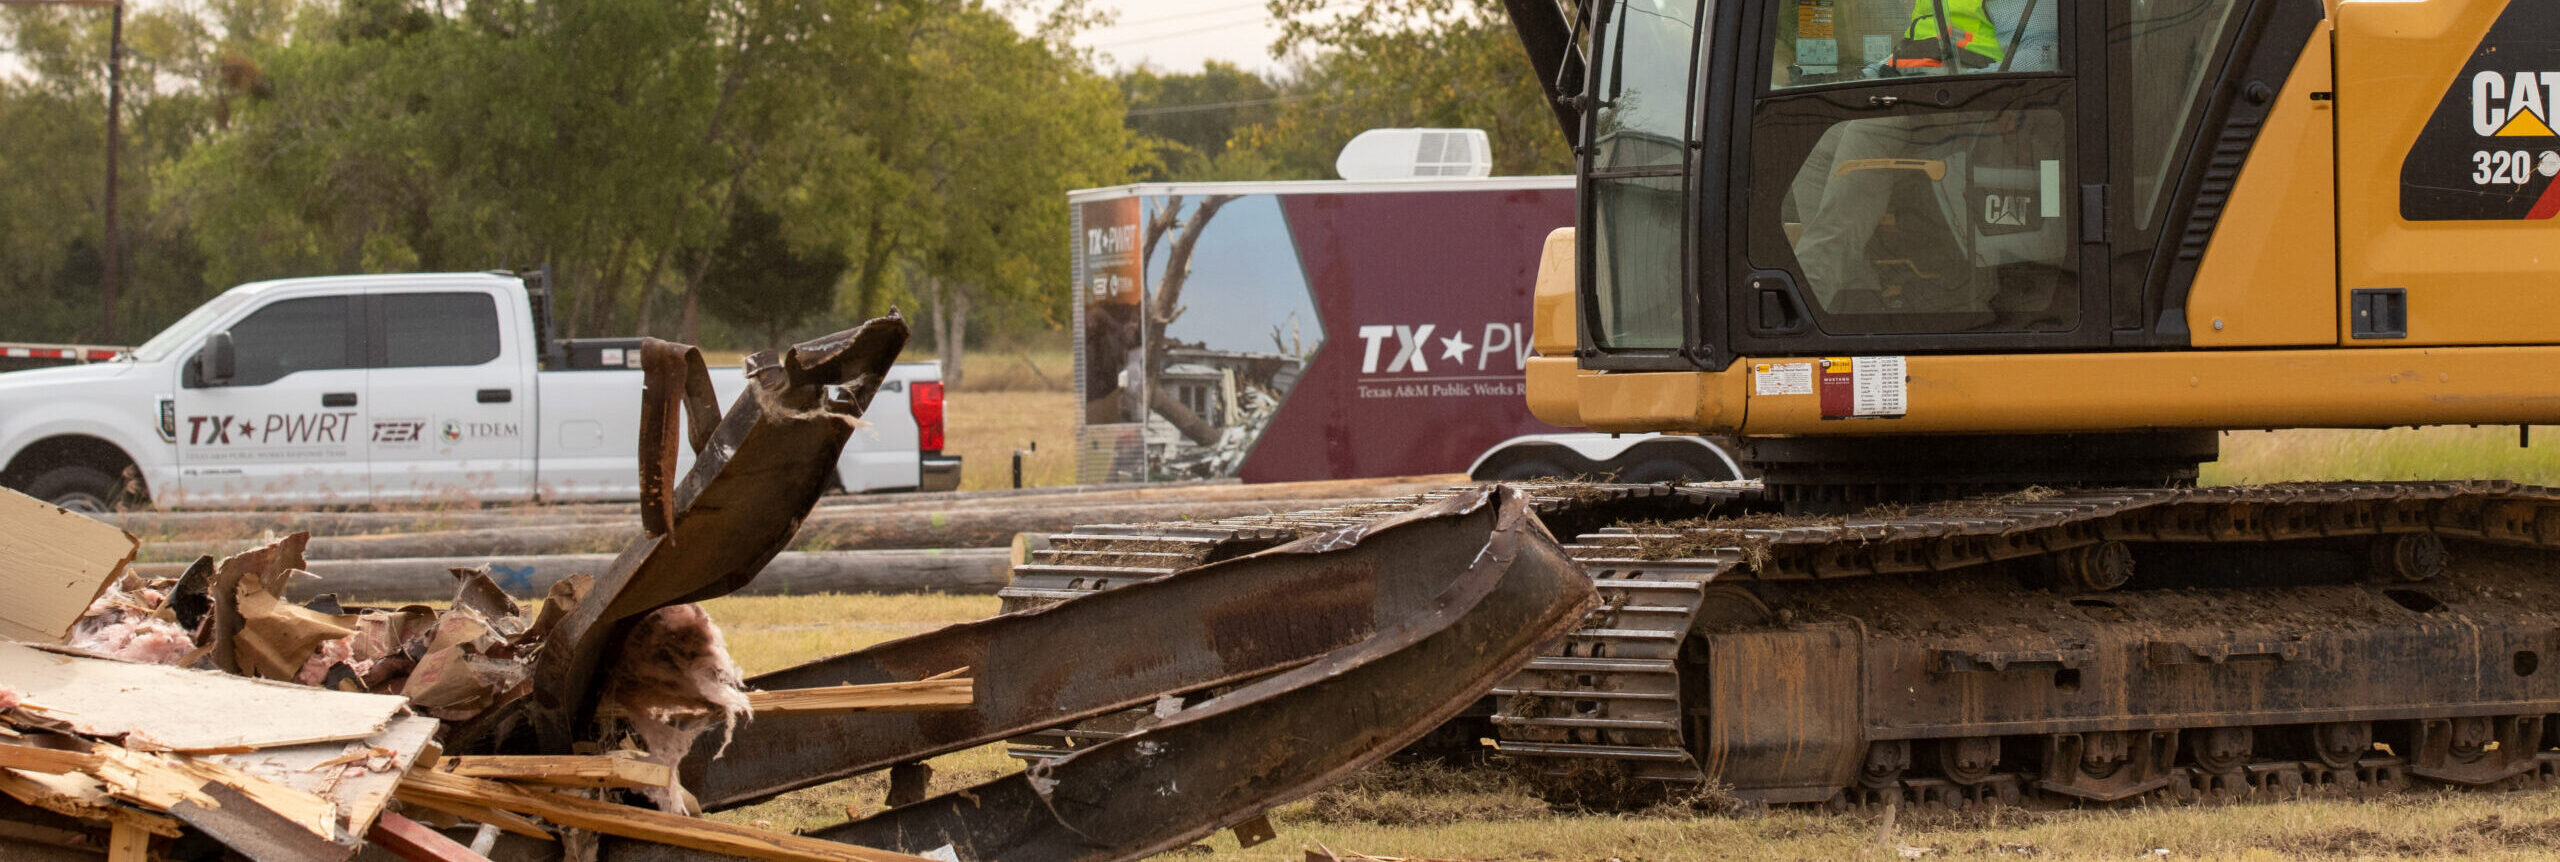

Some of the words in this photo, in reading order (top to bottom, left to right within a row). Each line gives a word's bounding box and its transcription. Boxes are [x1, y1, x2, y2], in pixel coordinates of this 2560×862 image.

[2472, 70, 2560, 137] CAT
[2472, 150, 2531, 185] 320
[1984, 194, 2031, 226] CAT
[1358, 324, 1436, 374] TX
[1358, 385, 1393, 398] Texas
[1394, 385, 1429, 398] A&M
[1432, 383, 1471, 397] Public
[1473, 382, 1514, 396] Works
[187, 414, 235, 445] TX
[262, 412, 358, 444] PWRT
[371, 421, 426, 442] TEEX
[467, 422, 520, 438] TDEM
